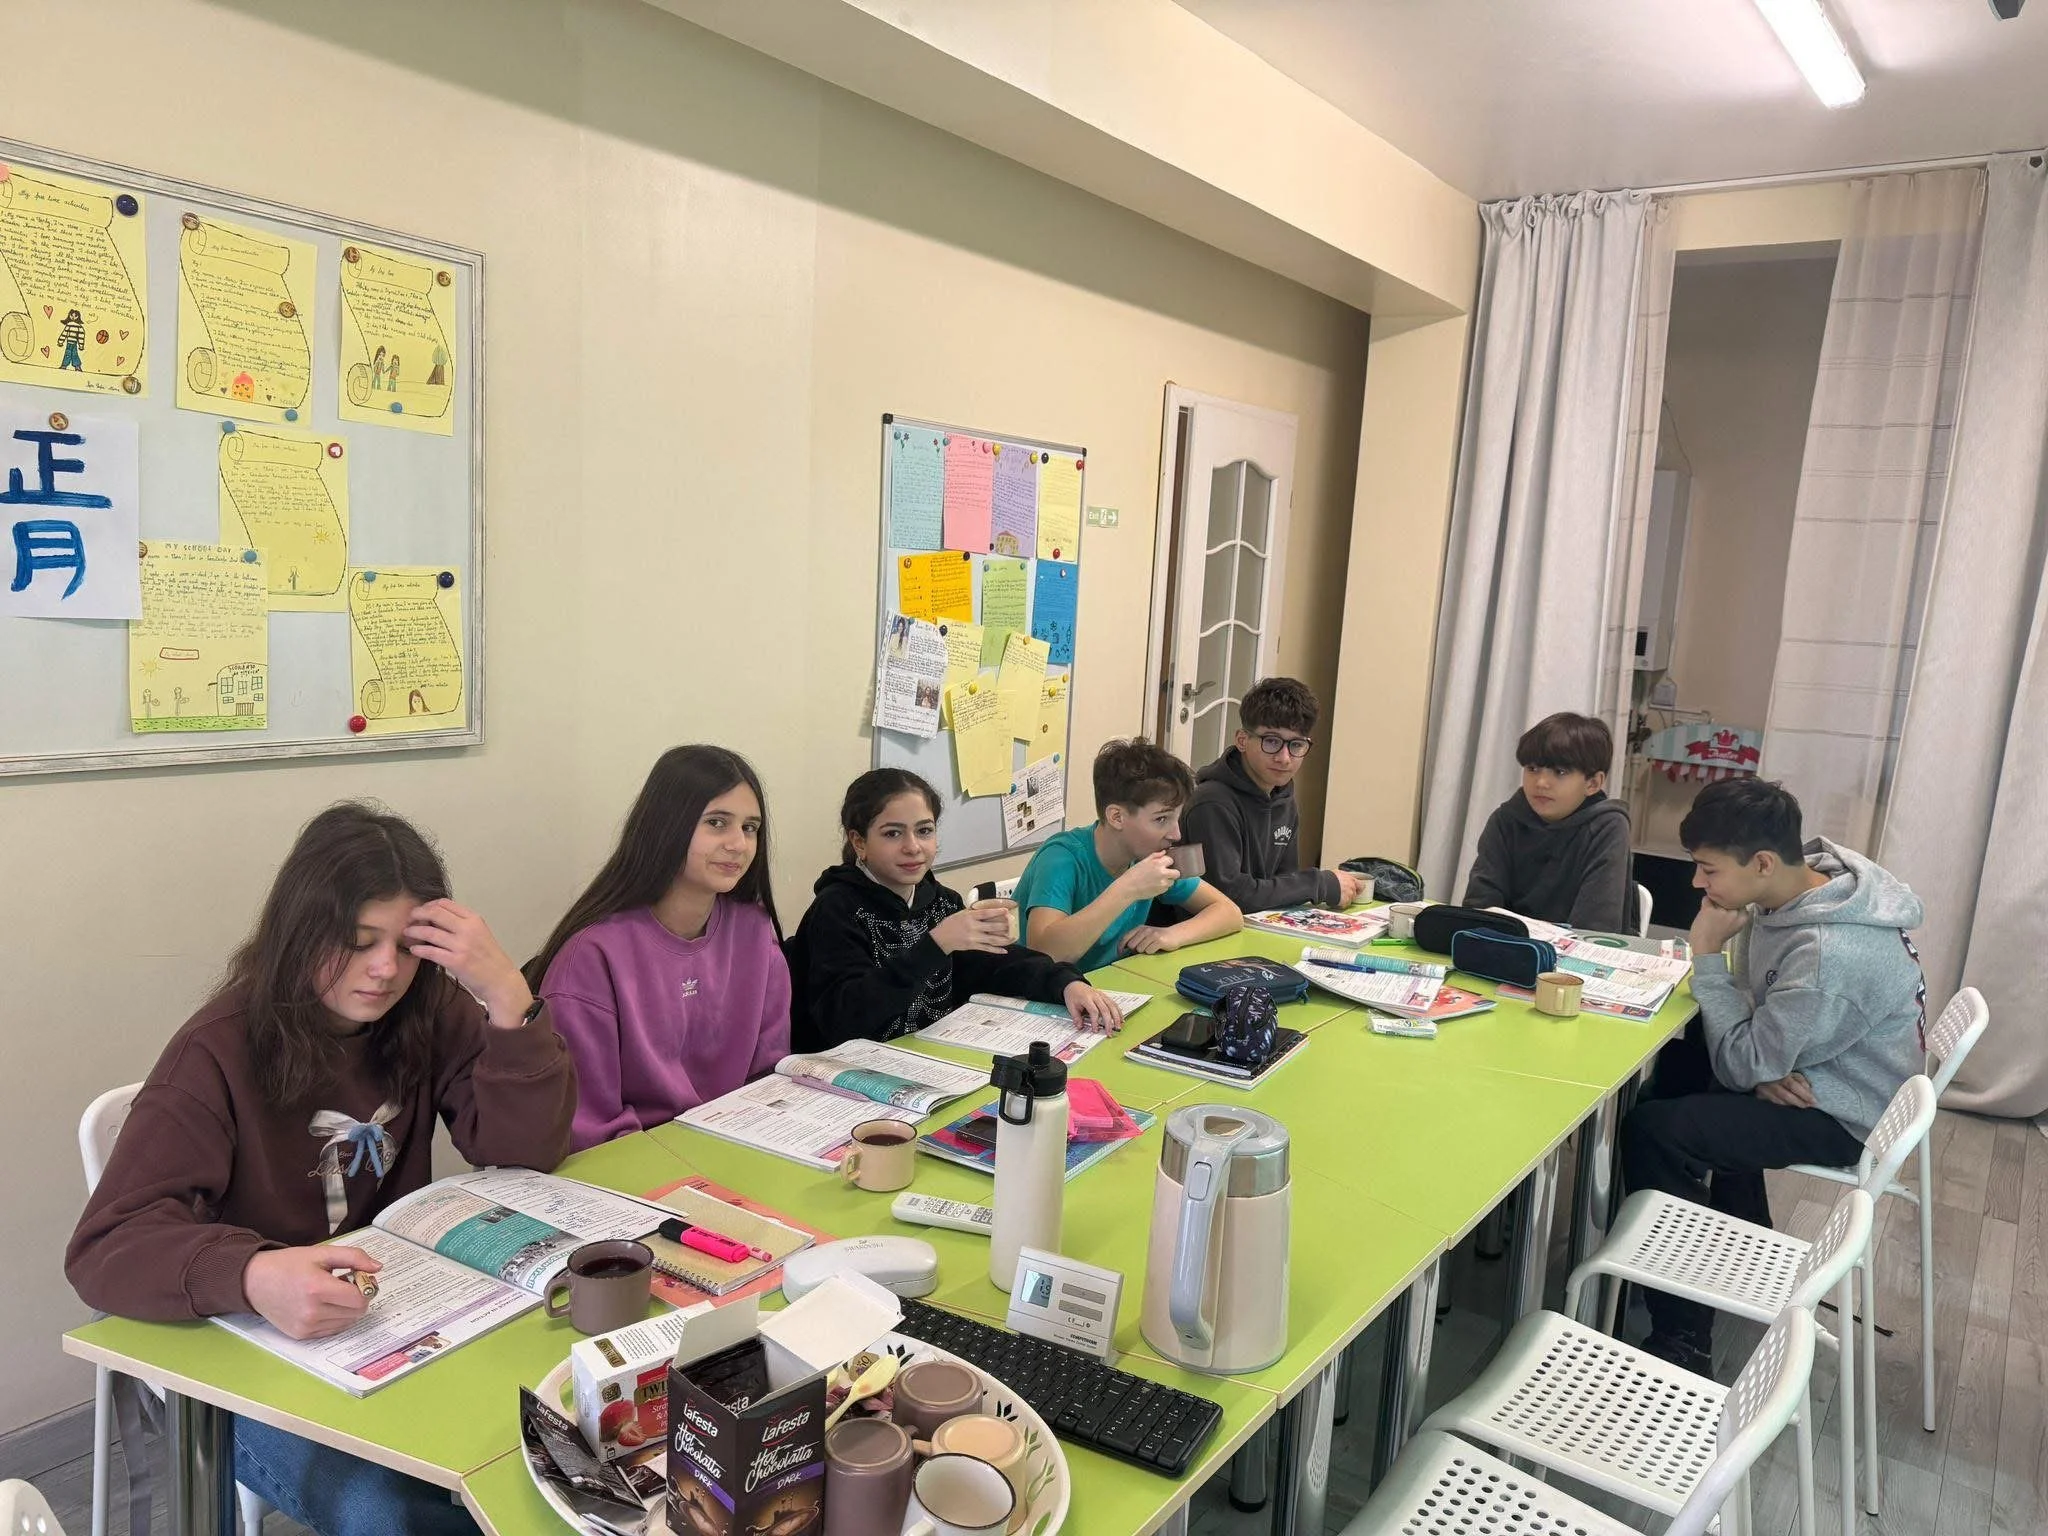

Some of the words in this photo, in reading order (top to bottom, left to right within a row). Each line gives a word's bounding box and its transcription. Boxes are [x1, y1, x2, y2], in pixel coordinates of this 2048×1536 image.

[536, 1401, 569, 1432] LaFesta
[683, 1403, 719, 1438] LaFesta
[761, 1411, 811, 1443] LaFesta
[677, 1422, 706, 1448] Hot
[751, 1444, 794, 1469] Hot
[694, 1468, 714, 1491] DARK
[776, 1472, 802, 1491] DARK
